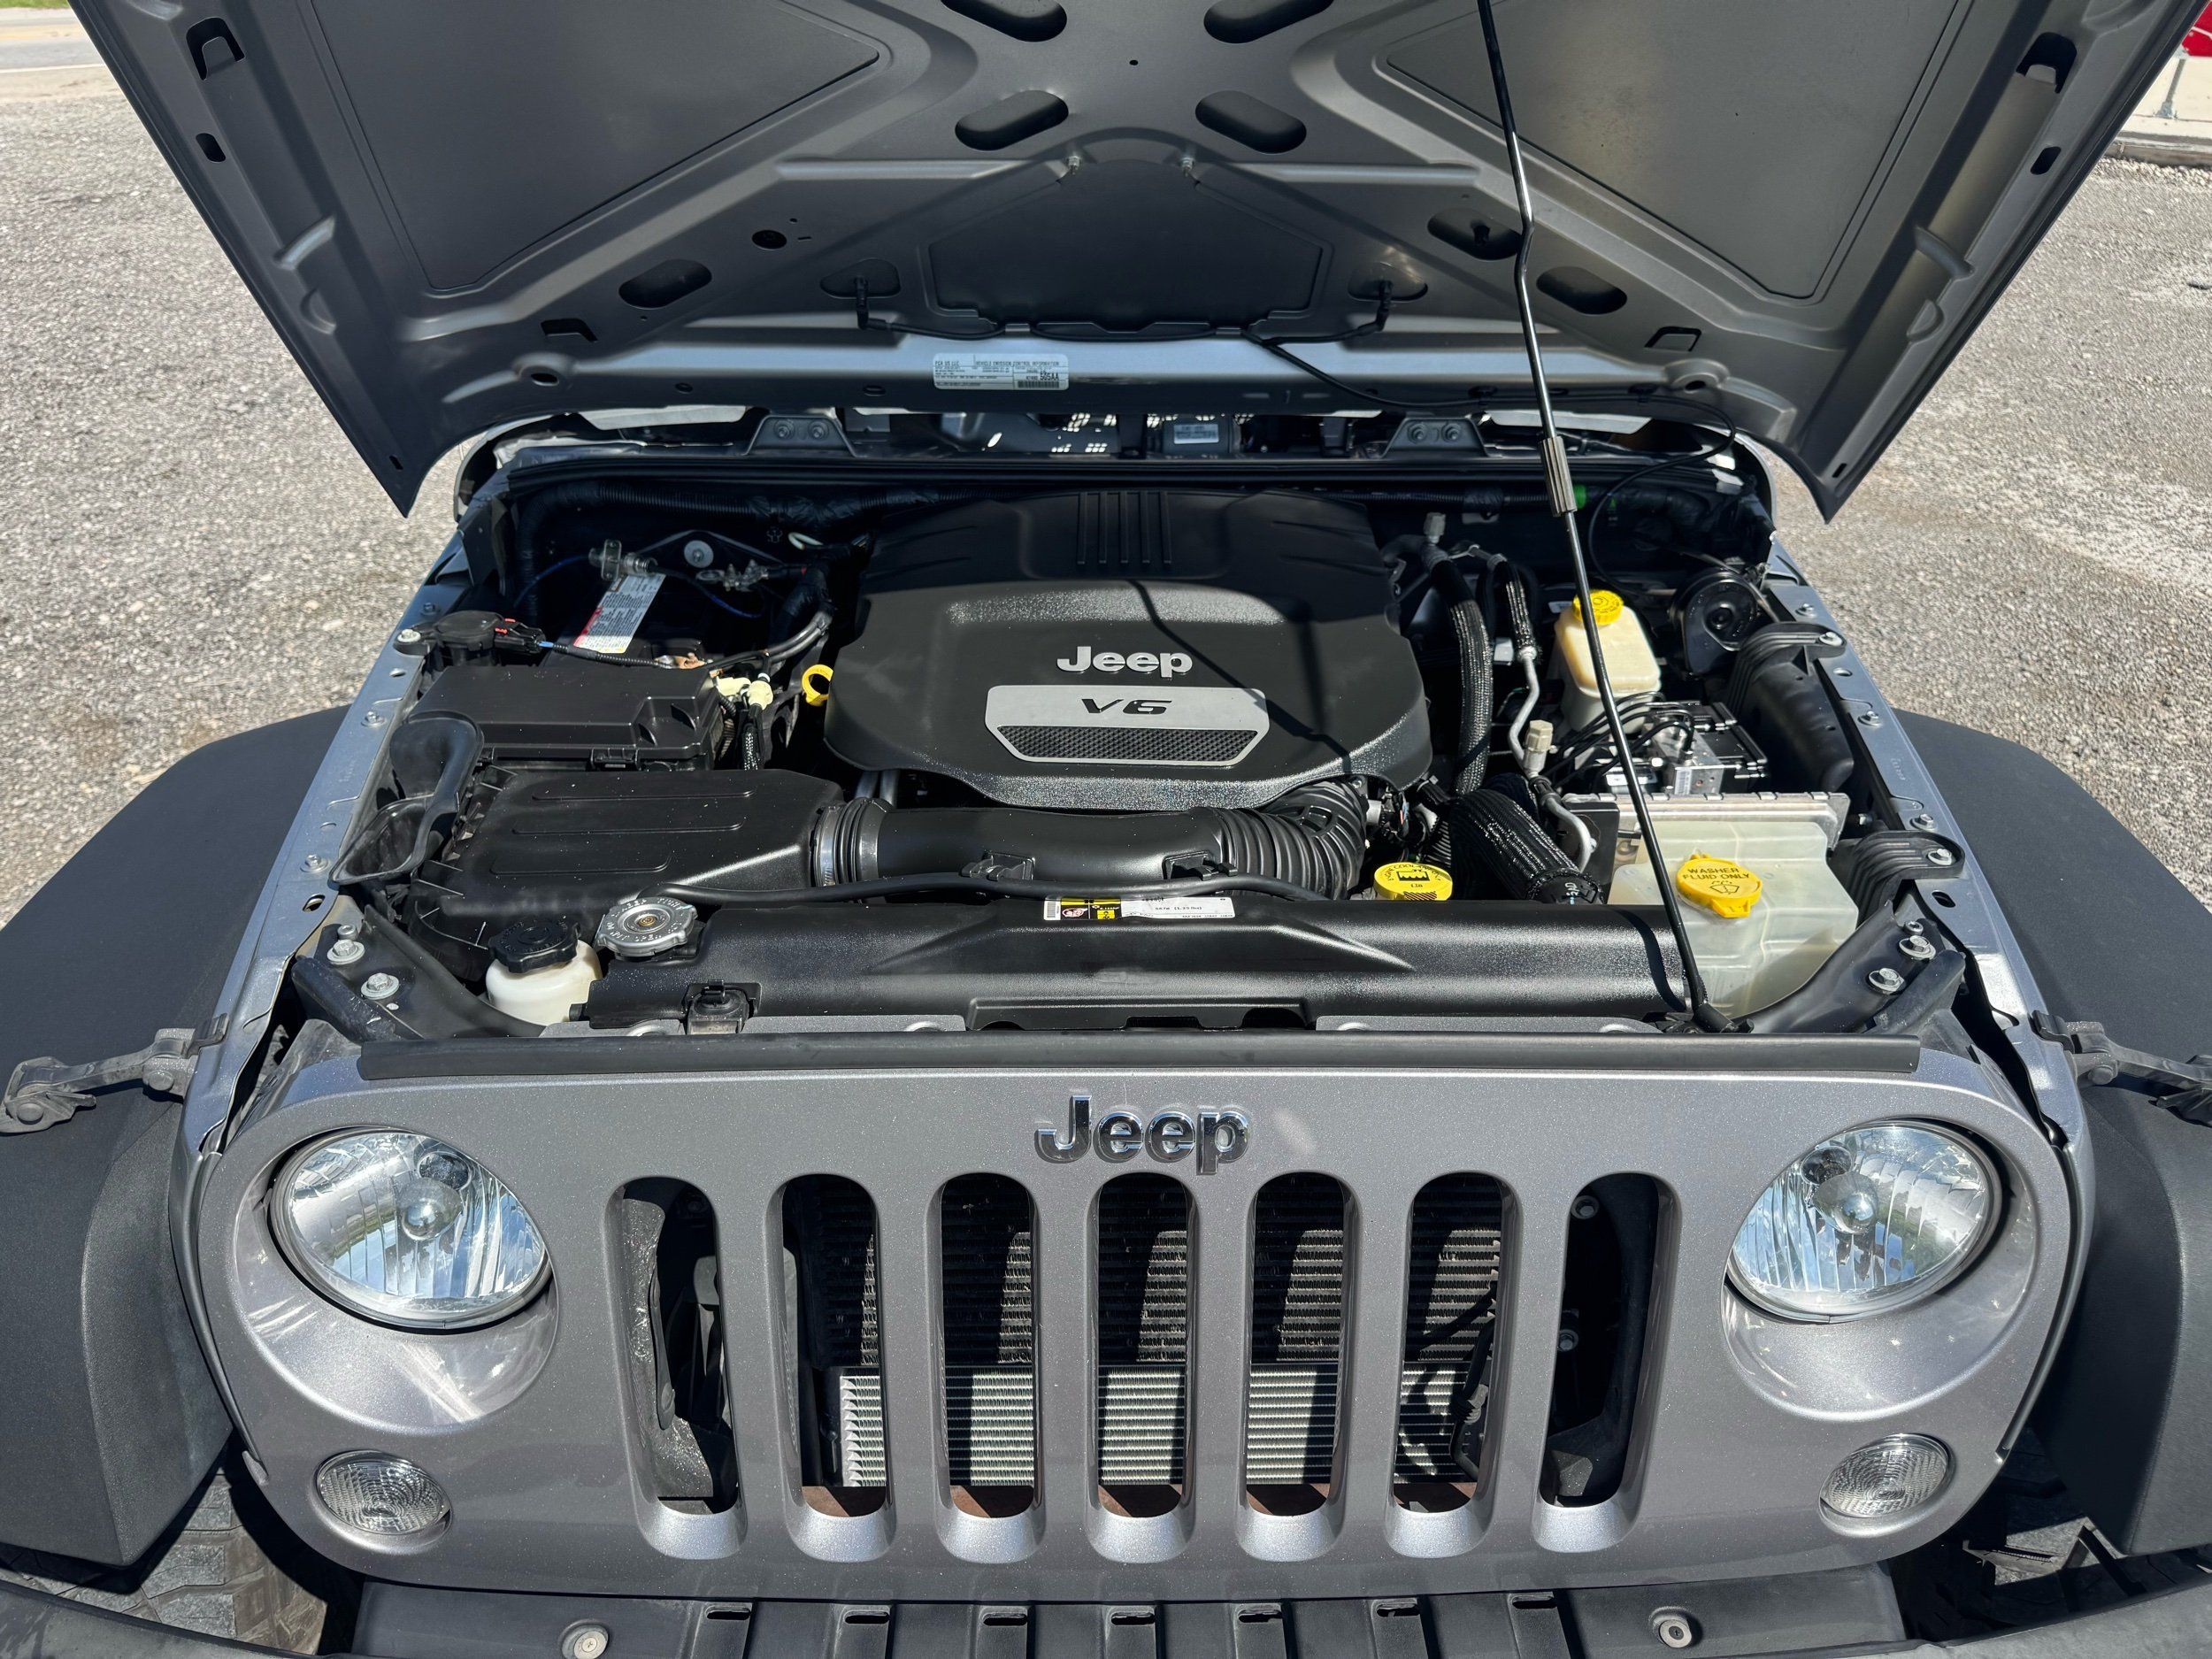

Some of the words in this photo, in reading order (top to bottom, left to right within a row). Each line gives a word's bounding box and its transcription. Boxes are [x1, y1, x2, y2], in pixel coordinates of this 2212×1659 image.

[1056, 646, 1193, 678] Jeep
[1081, 698, 1172, 715] V6
[1035, 1094, 1248, 1175] Jeep
